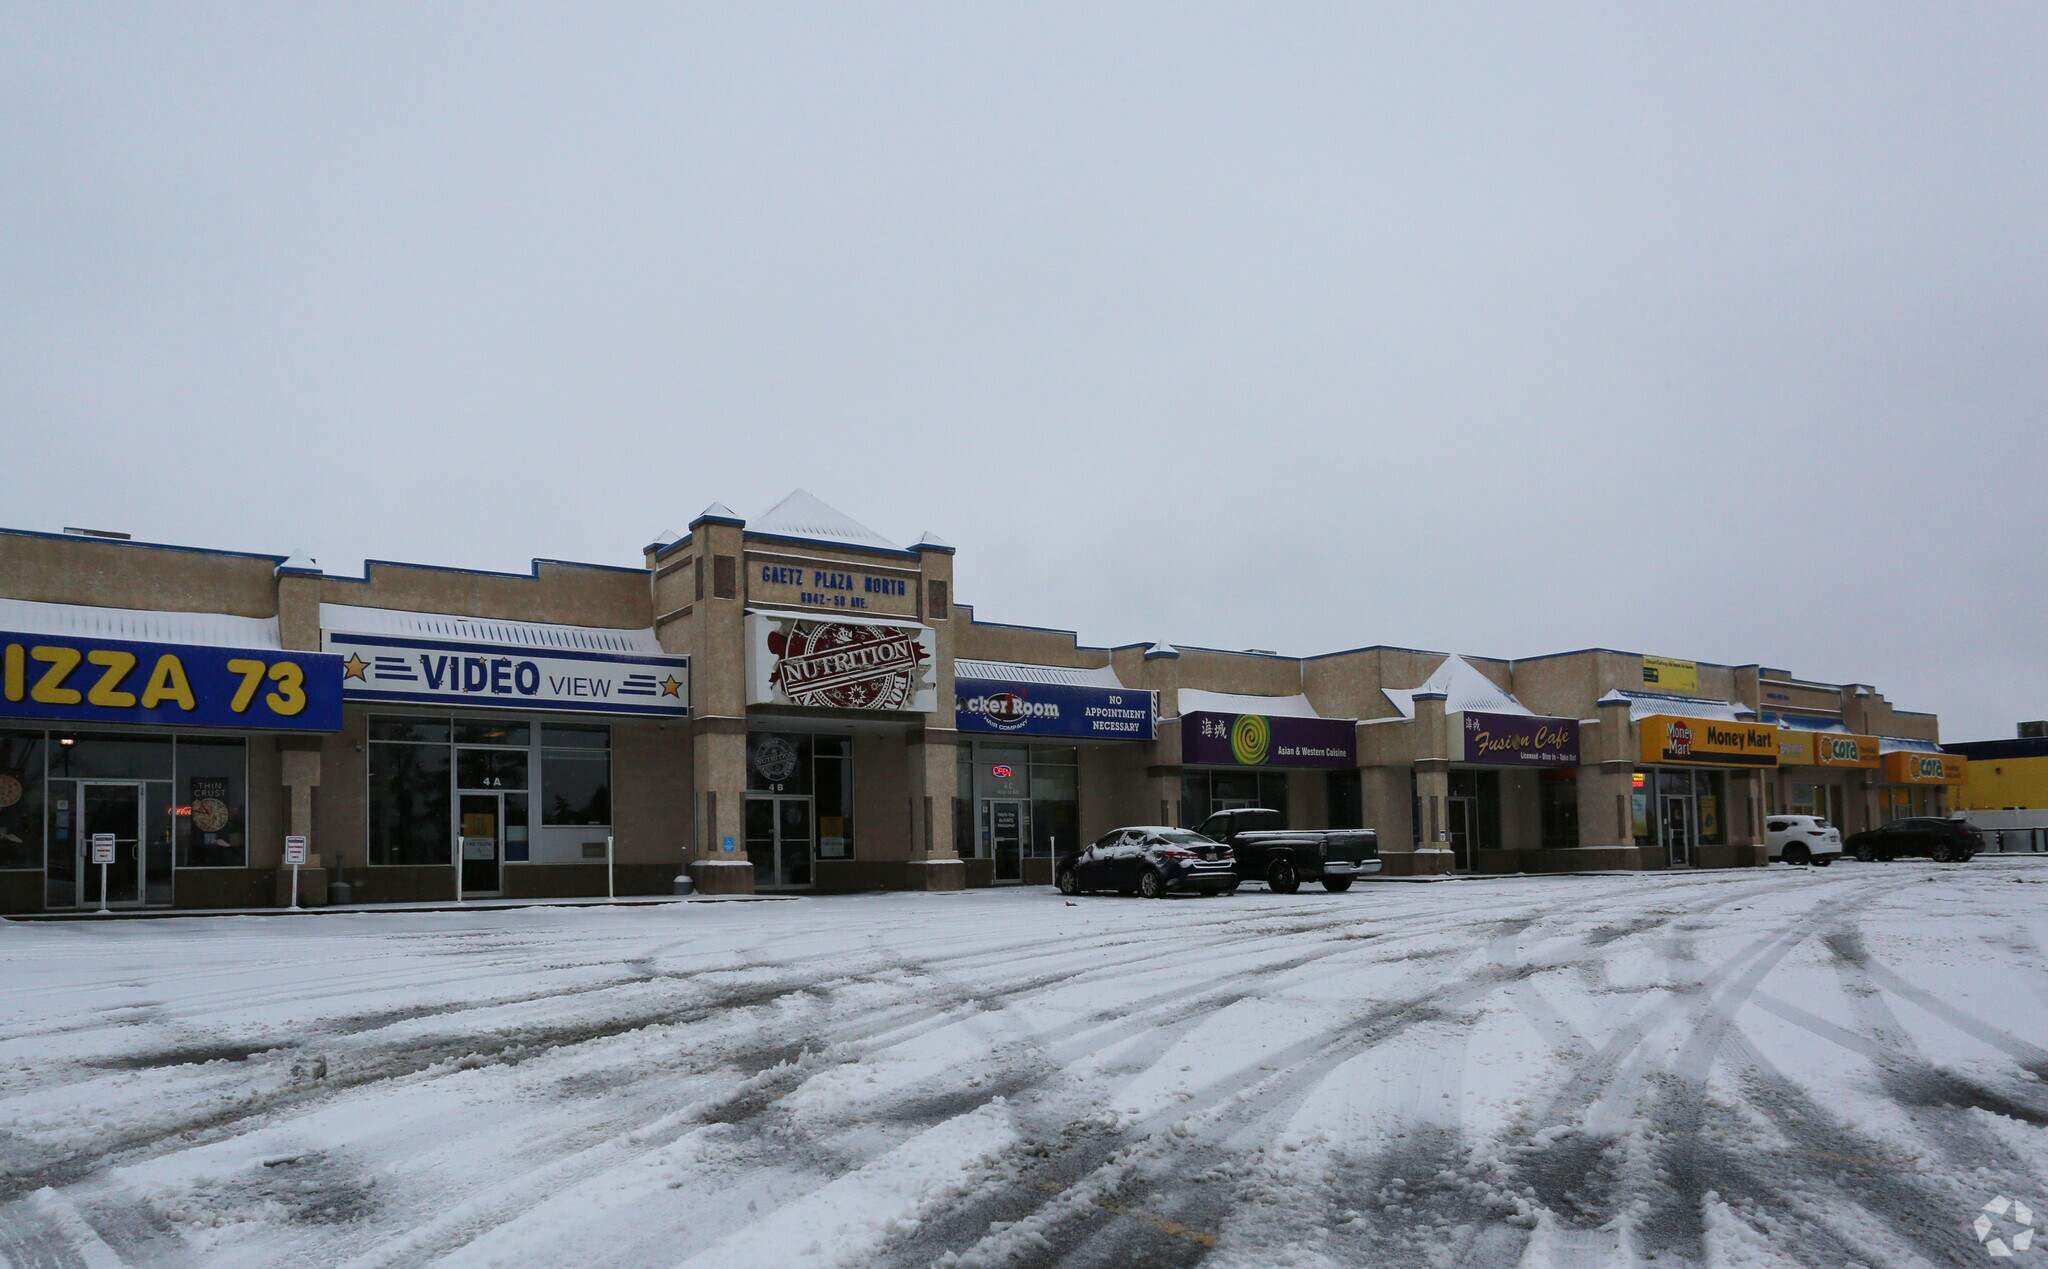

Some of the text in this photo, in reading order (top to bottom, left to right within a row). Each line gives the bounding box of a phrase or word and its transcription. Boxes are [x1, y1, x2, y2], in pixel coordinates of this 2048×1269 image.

[762, 566, 905, 596] GAETZ PLAZA NORTH
[851, 597, 868, 609] AVE.
[784, 640, 910, 683] NUTRITION
[0, 643, 307, 717] IZZA 73
[419, 654, 611, 698] VIDEO VIEW
[1012, 698, 1060, 717] Room
[1109, 695, 1123, 705] NO
[1085, 707, 1146, 719] APPOINTMENT
[983, 716, 1029, 731] HAIR COMPANY
[1092, 720, 1140, 732] NECESSARY
[1666, 722, 1694, 741] Money
[1708, 726, 1745, 750] Money
[1747, 729, 1772, 748] Mart
[1475, 731, 1531, 756] Fusion
[1669, 739, 1691, 755] Mart
[1278, 746, 1347, 757] Asian & Western Cuisine
[993, 766, 1012, 777] OPEN
[483, 777, 502, 786] 4 A
[769, 783, 775, 791] 4
[193, 789, 226, 797] CRUST
